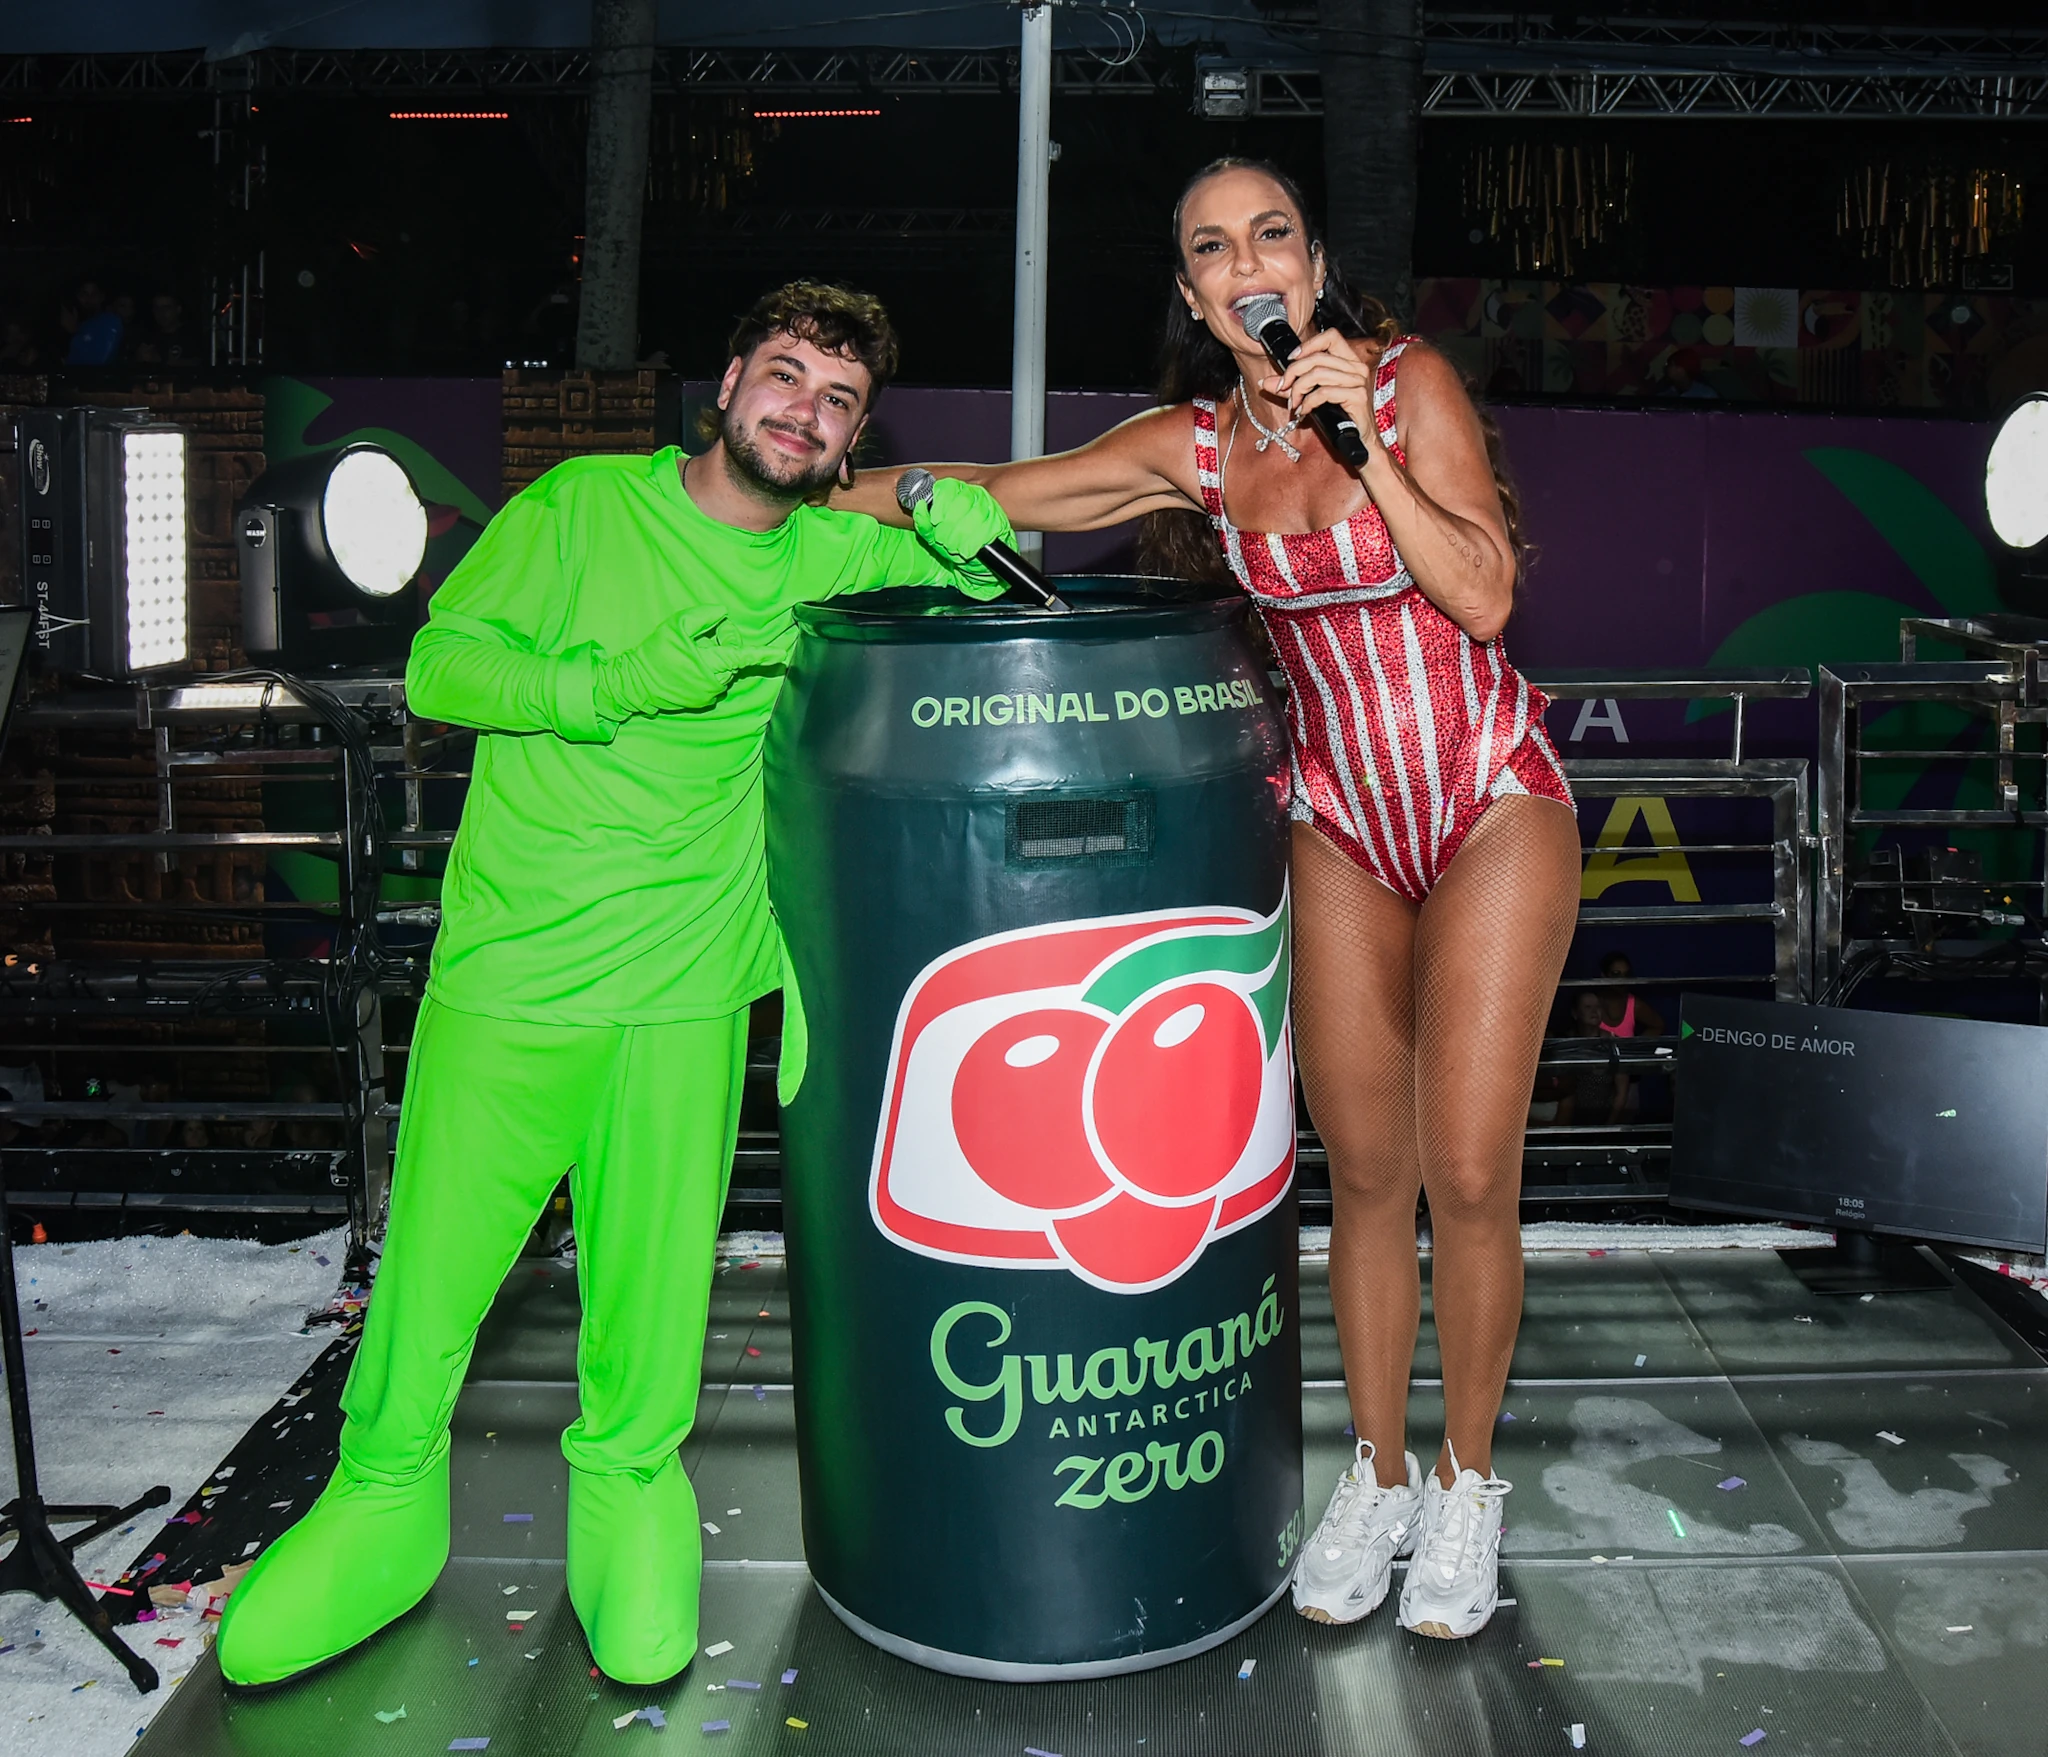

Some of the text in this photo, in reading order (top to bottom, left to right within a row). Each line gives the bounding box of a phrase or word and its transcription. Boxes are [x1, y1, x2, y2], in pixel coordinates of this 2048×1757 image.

[911, 679, 1264, 728] ORIGINAL DO BRASIL
[1771, 1034, 1796, 1051] DE
[1800, 1037, 1856, 1057] AMOR
[1837, 1196, 1865, 1209] 18:05
[930, 1273, 1285, 1448] Guaraná
[1049, 1371, 1253, 1439] ANTARCTICA
[1053, 1430, 1225, 1510] zero
